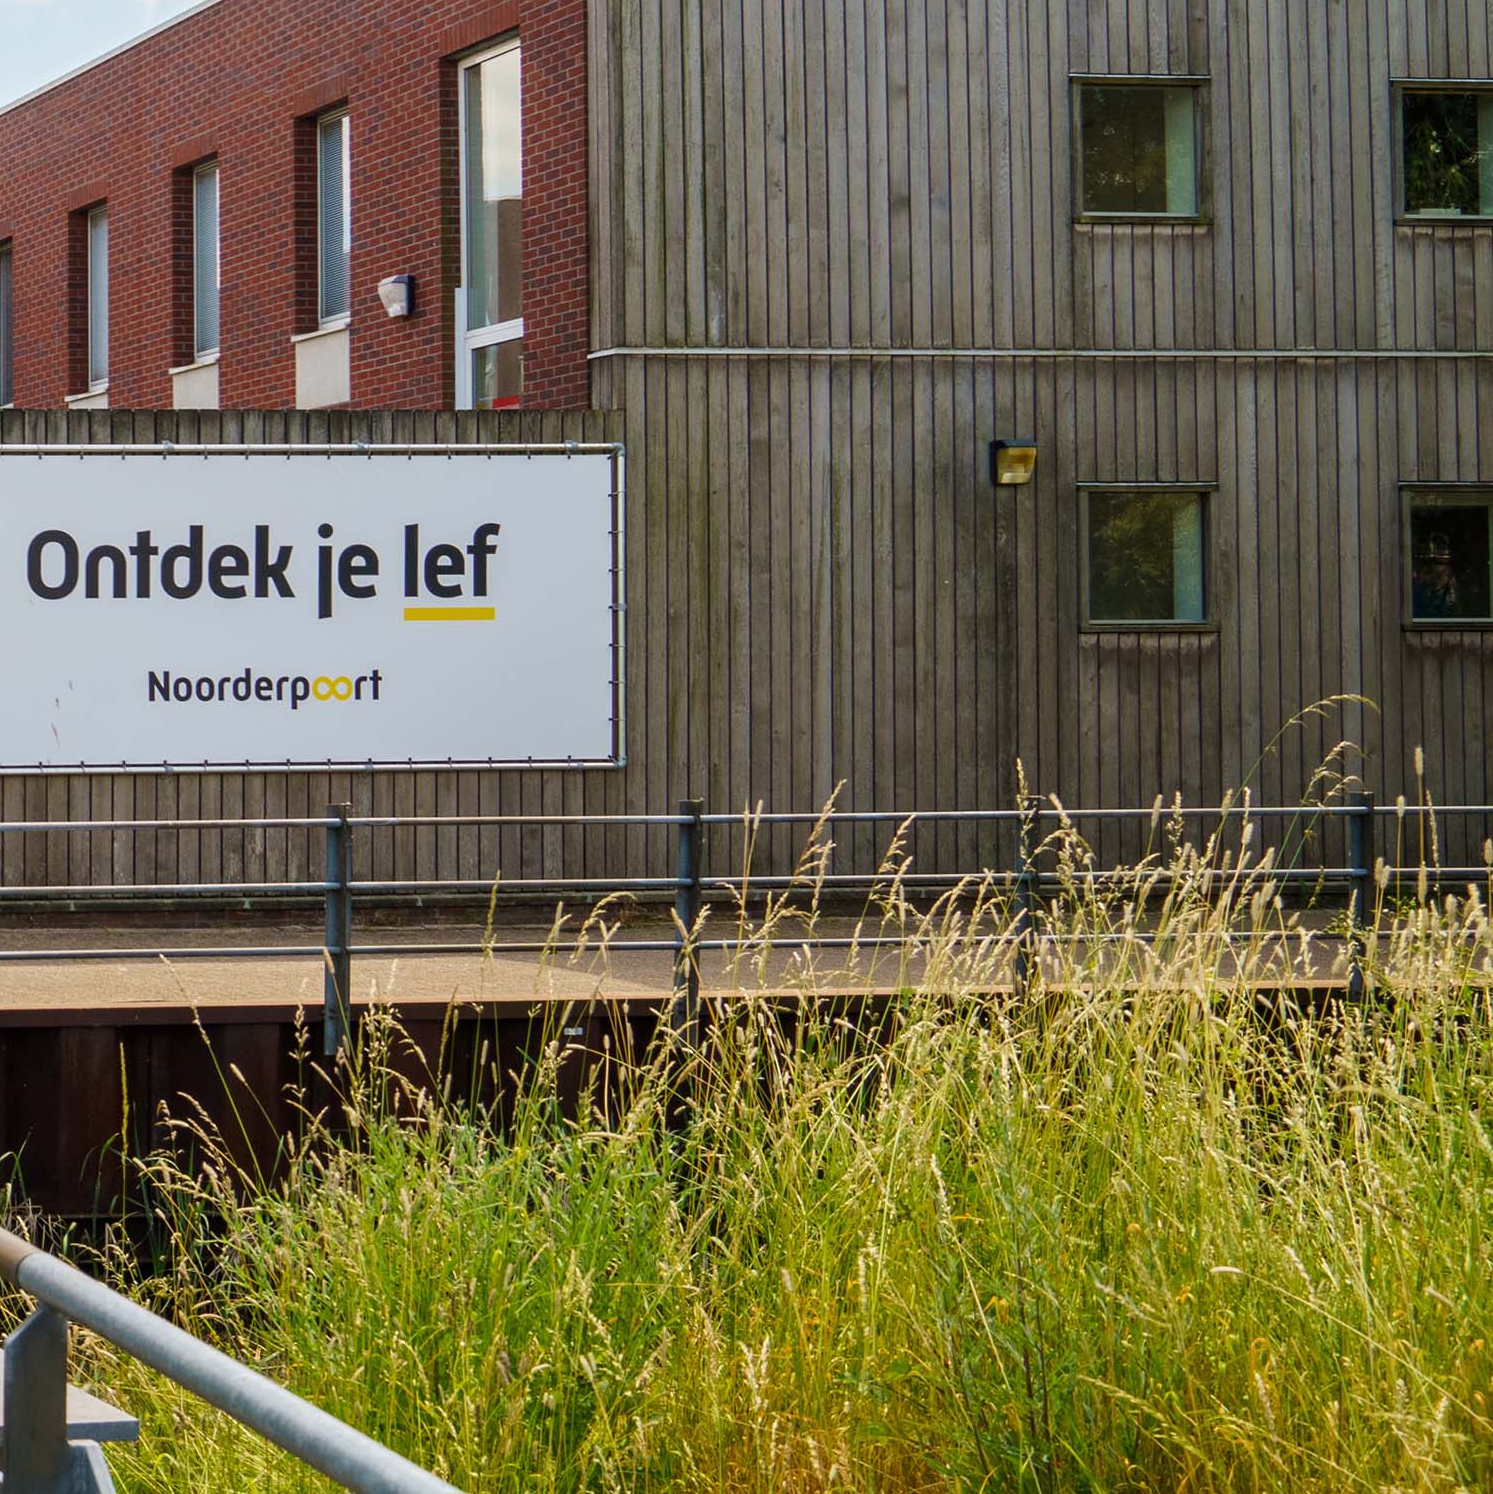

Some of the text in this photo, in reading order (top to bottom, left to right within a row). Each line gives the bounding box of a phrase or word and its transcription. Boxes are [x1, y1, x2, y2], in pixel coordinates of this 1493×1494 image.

[25, 521, 501, 620] Ontdek je lef
[147, 667, 383, 710] Noorderpoort
